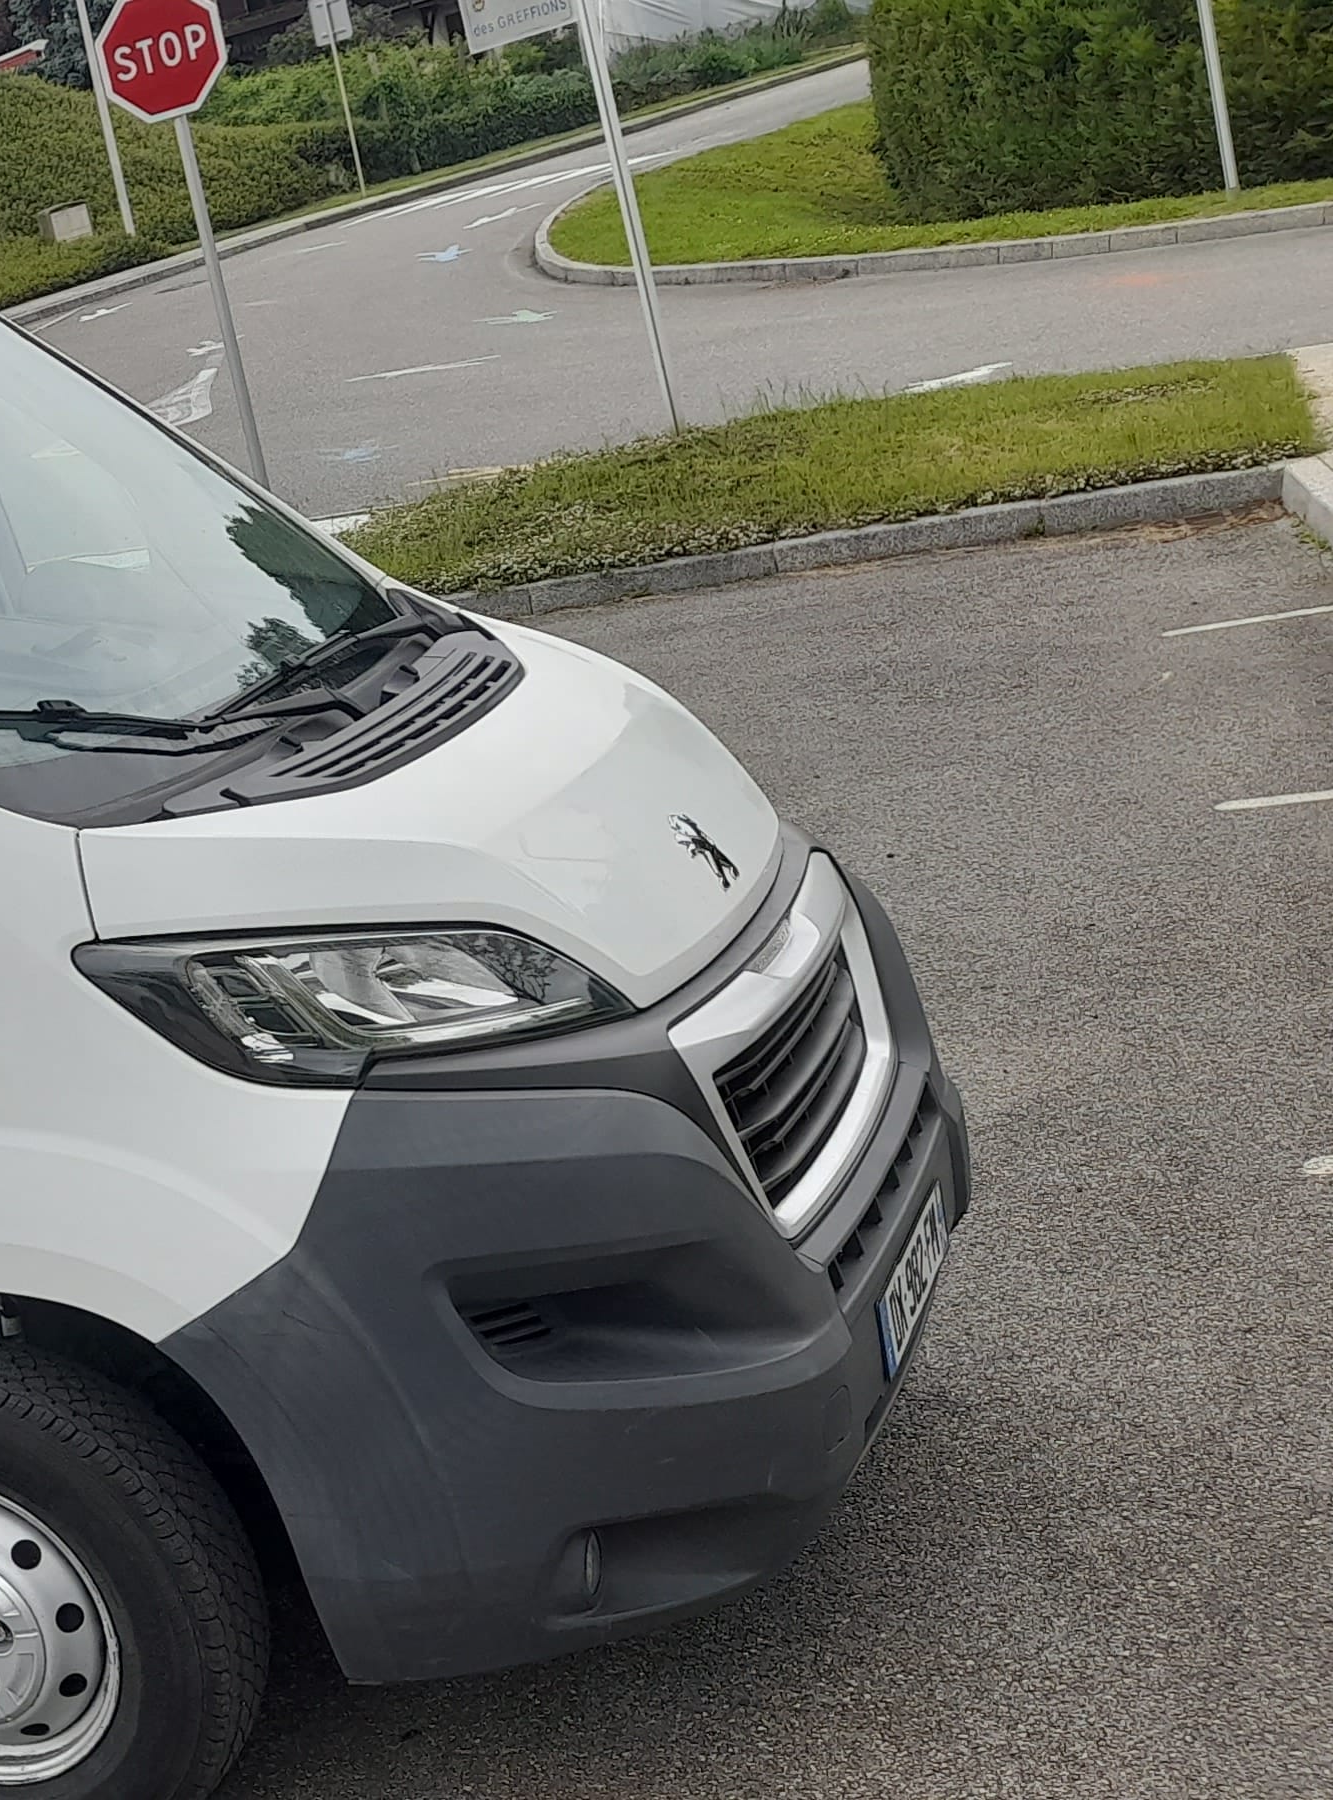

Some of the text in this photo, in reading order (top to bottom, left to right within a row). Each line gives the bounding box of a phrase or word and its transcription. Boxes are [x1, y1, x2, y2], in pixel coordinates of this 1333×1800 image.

[473, 0, 567, 37] des GREFFIONS
[113, 23, 207, 82] STOP
